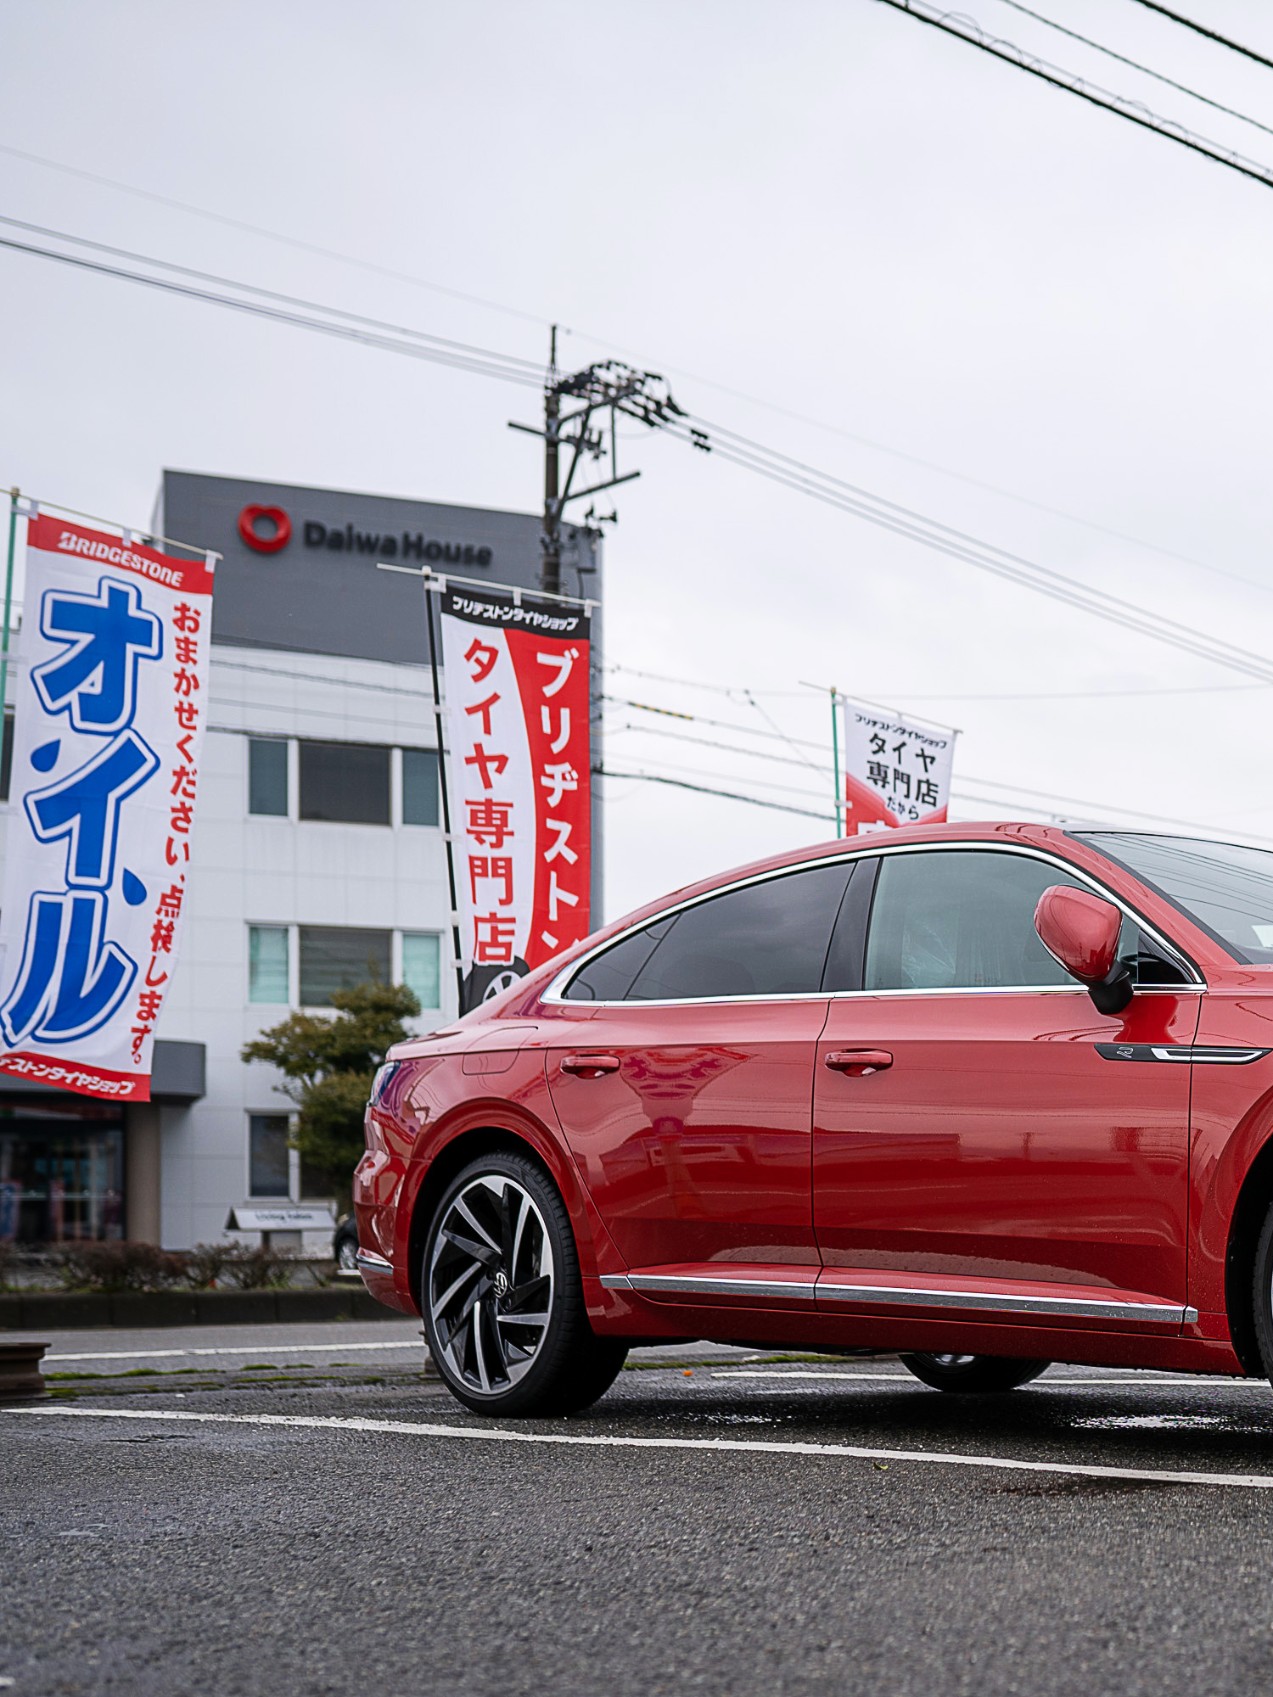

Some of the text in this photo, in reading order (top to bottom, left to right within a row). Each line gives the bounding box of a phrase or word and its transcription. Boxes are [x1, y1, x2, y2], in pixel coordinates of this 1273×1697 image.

[58, 531, 184, 587] BRIDGESTONE
[868, 732, 937, 773] タイヤ
[0, 575, 163, 1048] オイル
[464, 638, 516, 965] タイヤ専門店
[866, 760, 939, 808] 専門店
